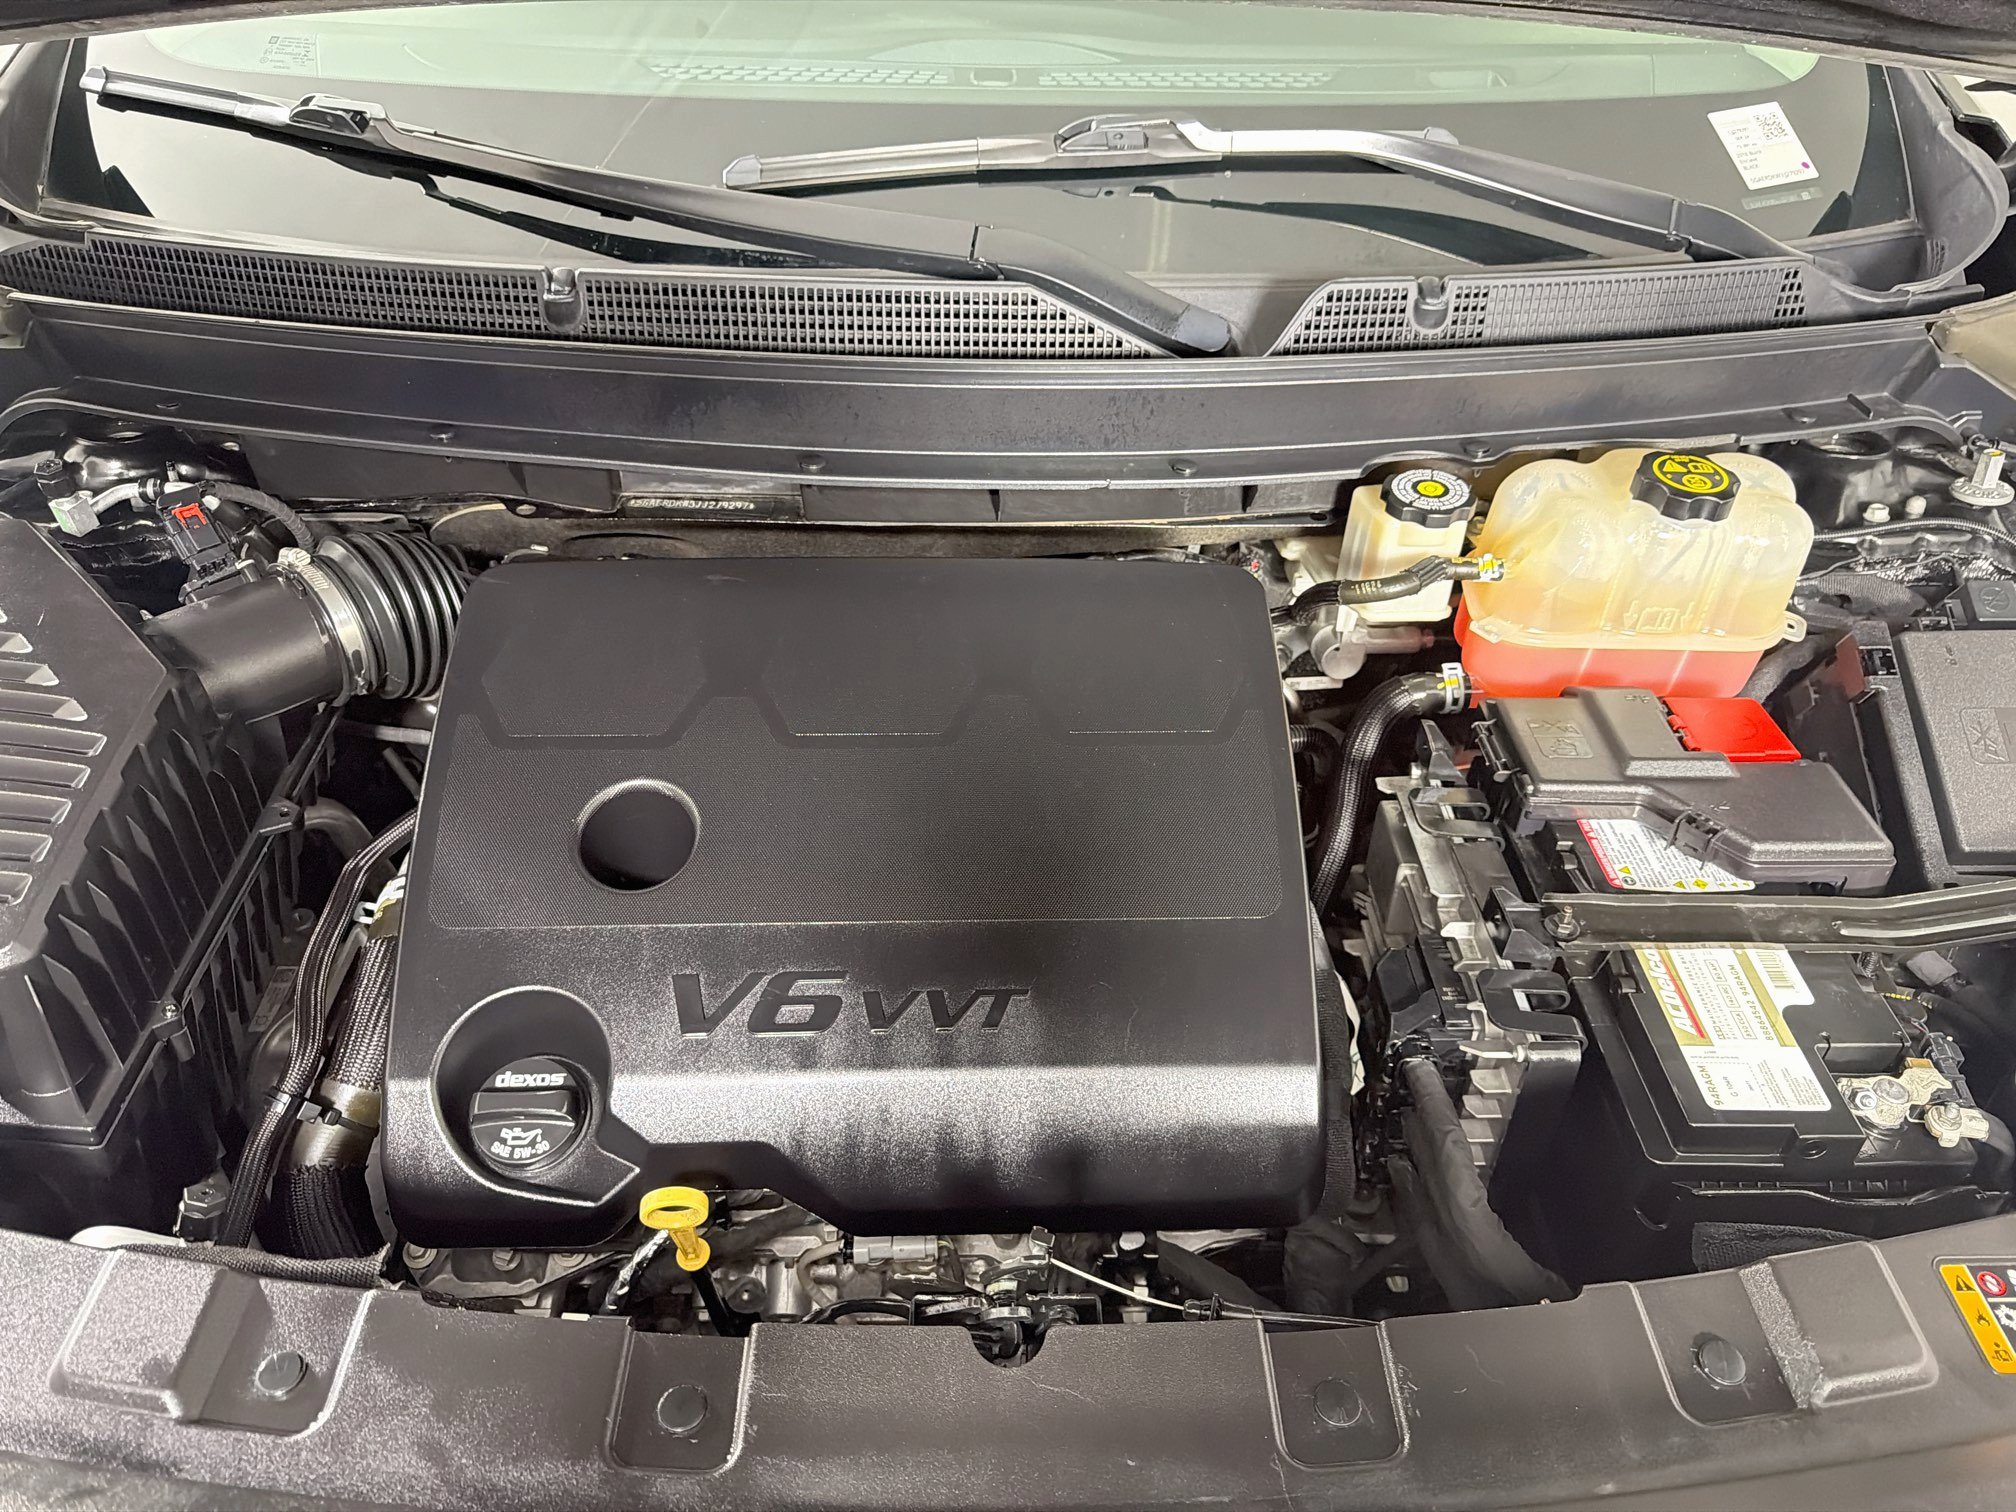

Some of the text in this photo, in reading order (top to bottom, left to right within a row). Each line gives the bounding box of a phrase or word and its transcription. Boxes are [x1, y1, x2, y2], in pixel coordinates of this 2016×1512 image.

[1728, 964, 1750, 996] 94RAGM
[672, 969, 1031, 1039] V6 VVT
[494, 1071, 568, 1088] dexos
[1697, 1065, 1725, 1106] 94RAGM
[490, 1139, 551, 1160] SAE 5W-30
